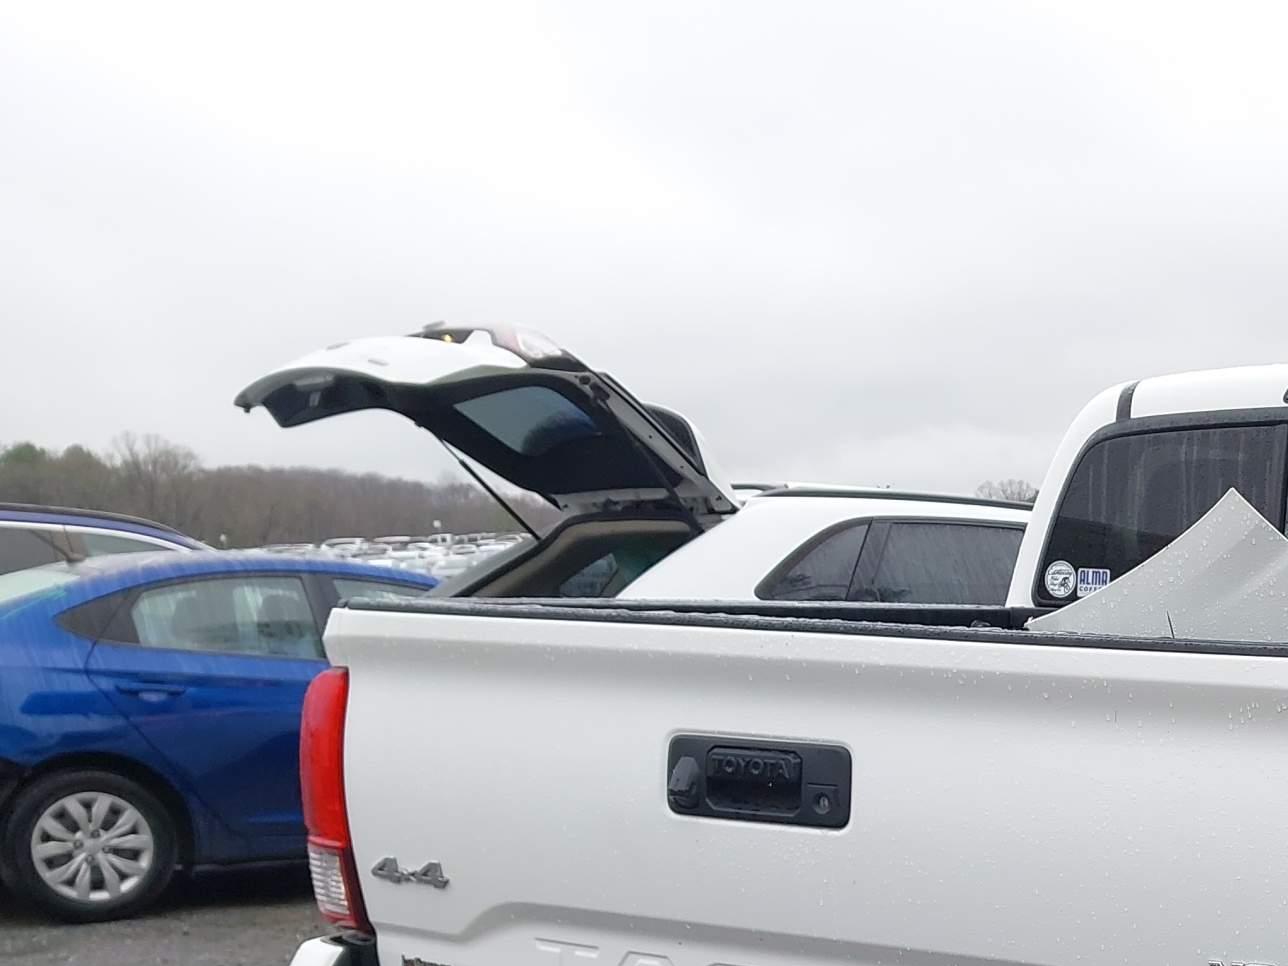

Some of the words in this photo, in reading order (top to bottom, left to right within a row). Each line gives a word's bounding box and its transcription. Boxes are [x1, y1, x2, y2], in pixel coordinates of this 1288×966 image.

[1080, 570, 1108, 586] ALMA
[711, 755, 790, 779] TOYOTA
[371, 857, 449, 889] 4x4
